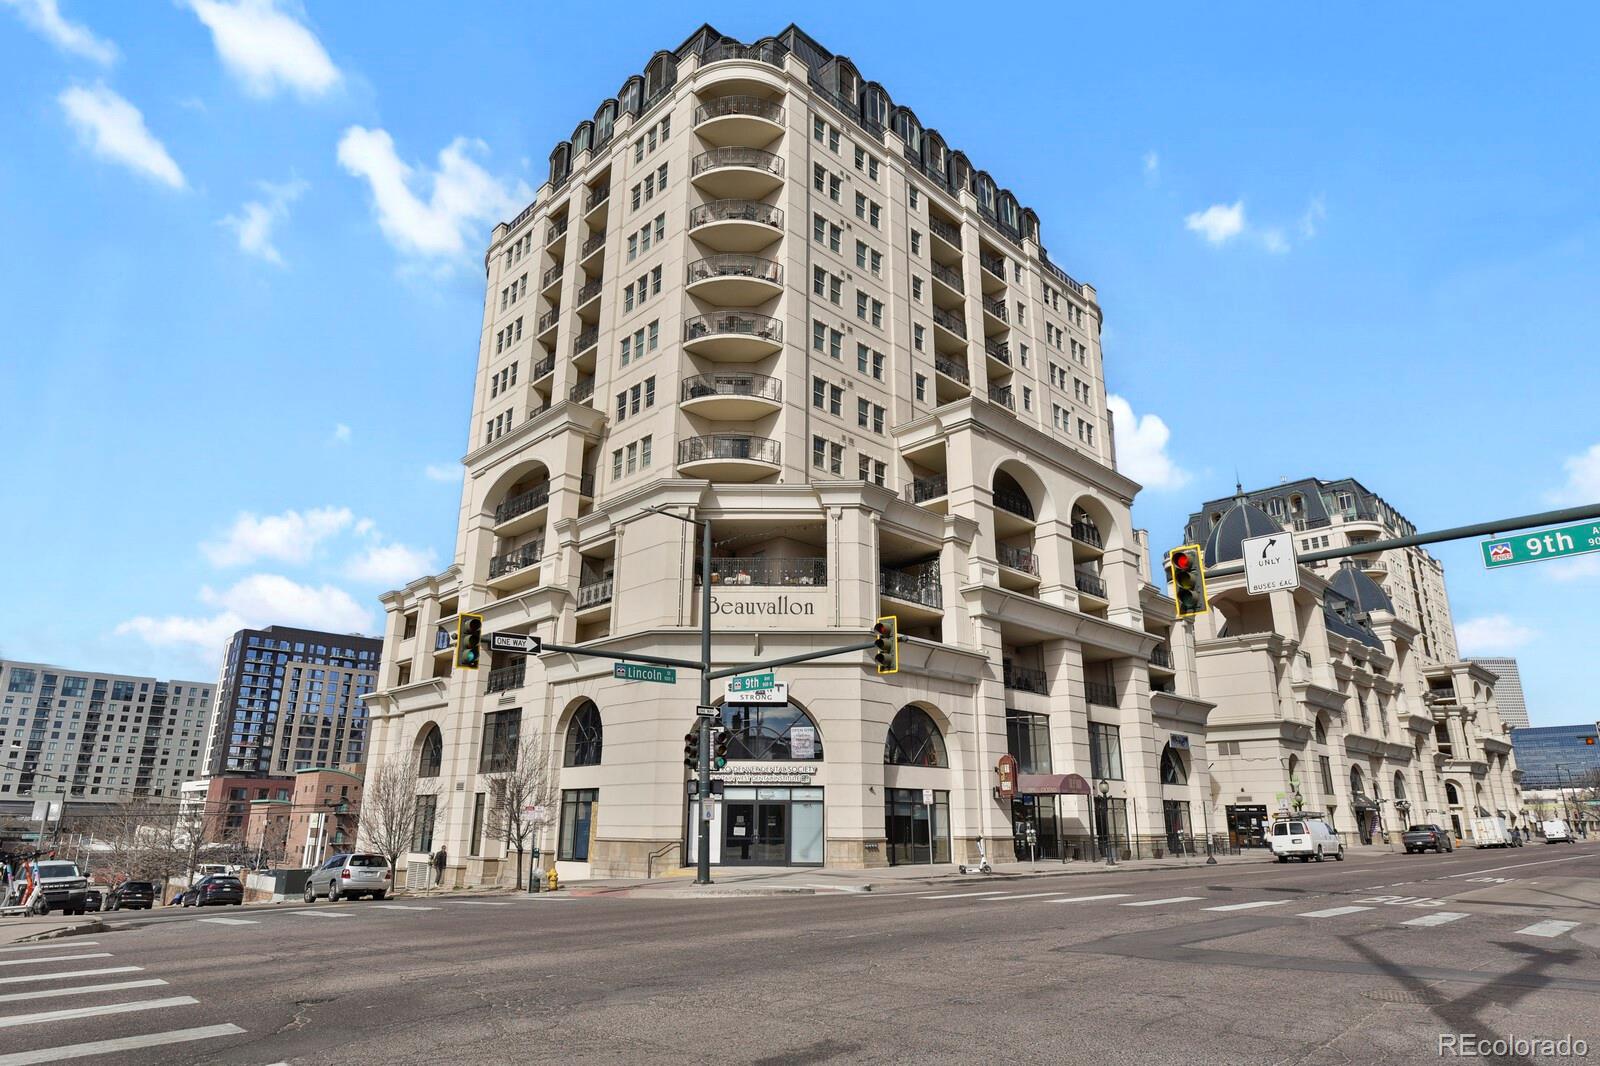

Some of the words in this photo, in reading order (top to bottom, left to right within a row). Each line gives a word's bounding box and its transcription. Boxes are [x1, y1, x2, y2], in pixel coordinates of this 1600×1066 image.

[1592, 526, 1600, 535] A
[1526, 532, 1574, 556] 9th
[1253, 581, 1276, 591] BUSES
[709, 595, 815, 615] Beauvallon
[496, 637, 511, 646] ONE
[512, 639, 527, 647] WAY
[628, 667, 662, 681] Lincoln
[745, 676, 759, 689] 9th
[788, 766, 818, 775] SOCIETY
[1352, 895, 1447, 907] BUS
